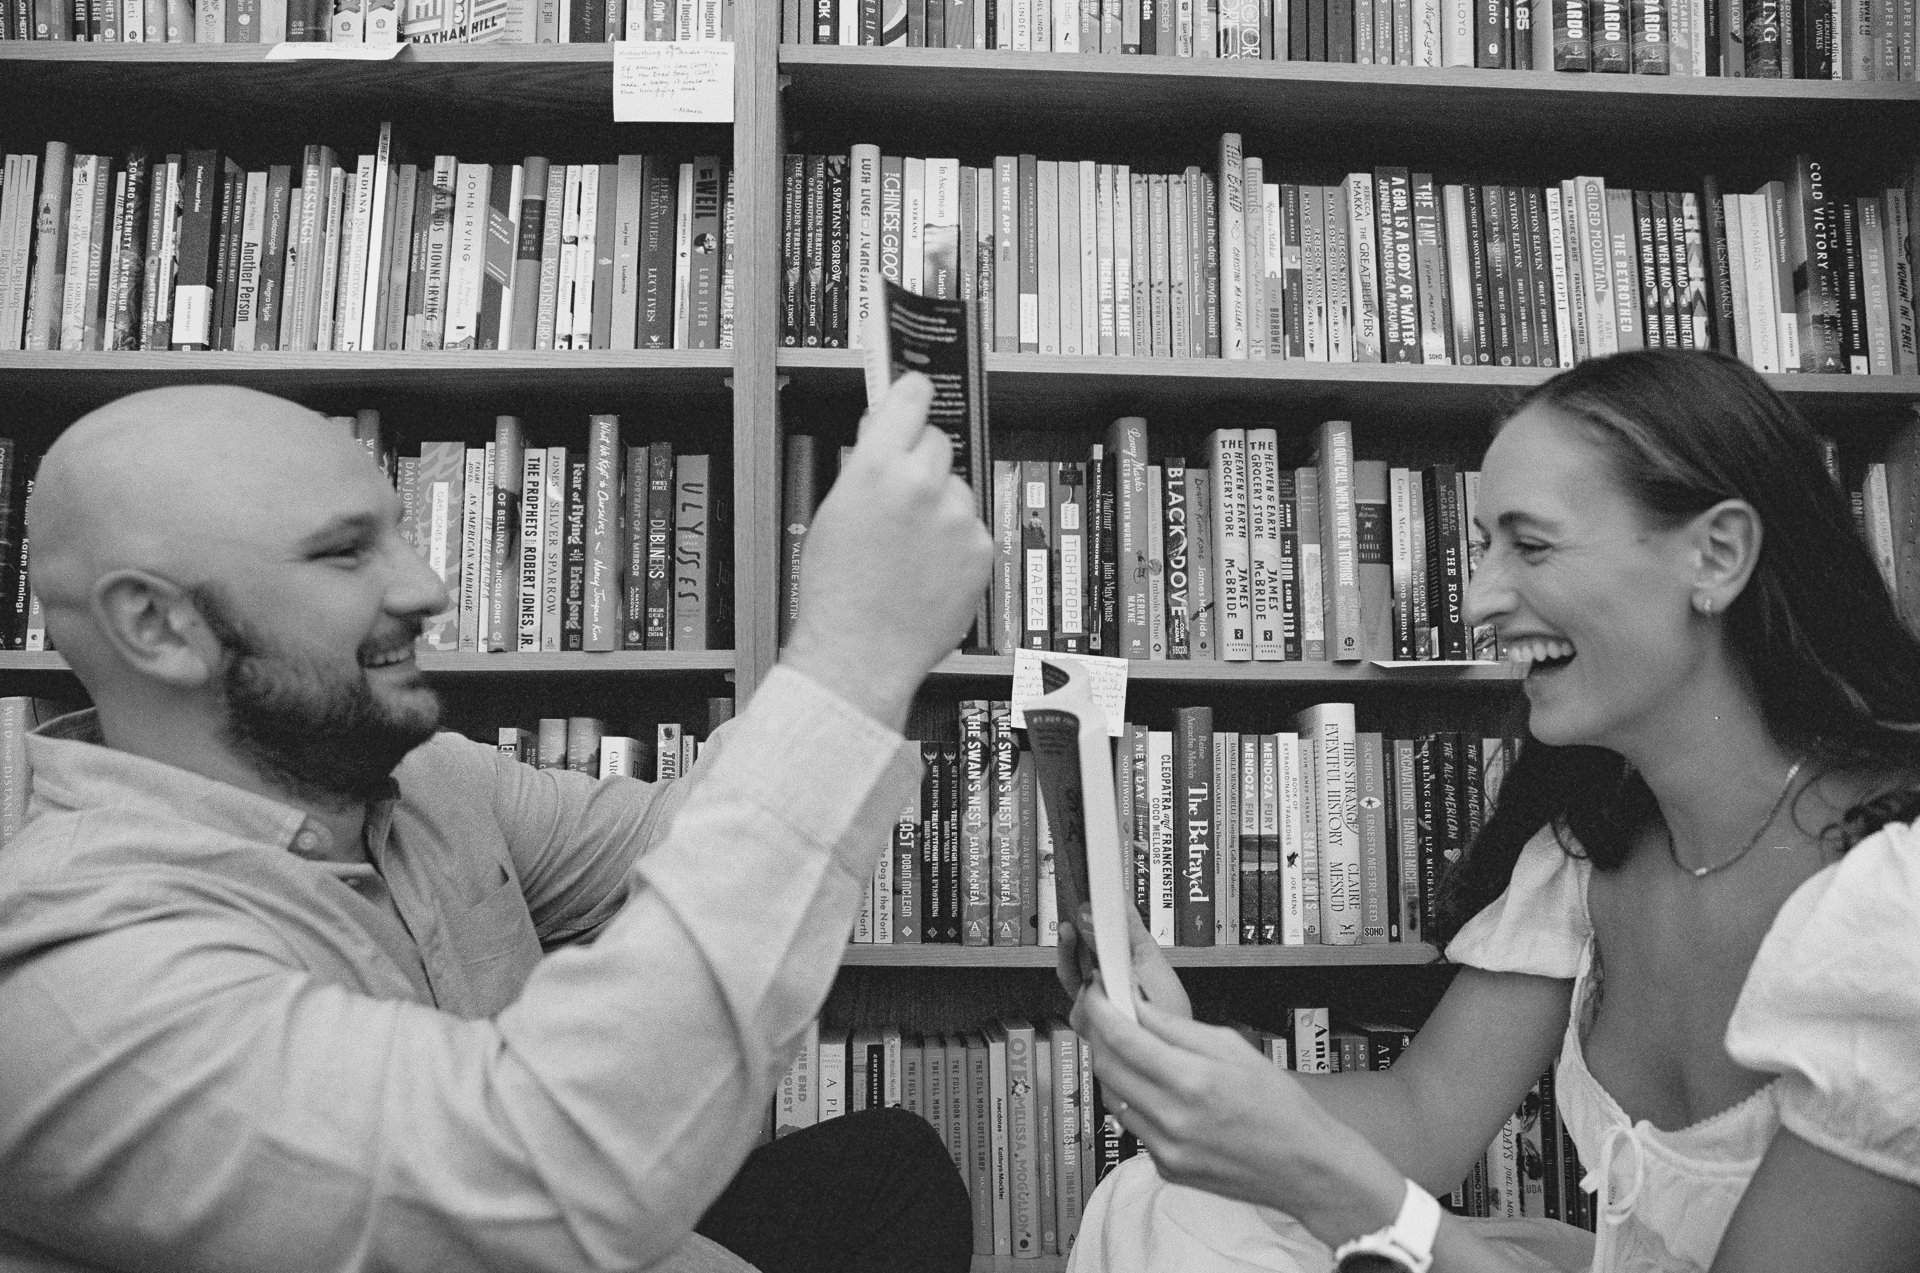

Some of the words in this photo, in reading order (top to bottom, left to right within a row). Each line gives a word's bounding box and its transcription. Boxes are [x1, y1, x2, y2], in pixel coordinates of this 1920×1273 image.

[413, 26, 466, 43] NATHAN
[472, 16, 497, 34] HILL
[1885, 32, 1893, 66] NAMES
[127, 161, 137, 199] TOWARD
[437, 170, 448, 188] THE
[861, 158, 871, 183] LUSH
[1002, 164, 1010, 182] THE
[1392, 177, 1405, 185] A
[1810, 163, 1823, 200] COLD
[234, 183, 243, 204] JENNY
[273, 199, 282, 212] Last
[274, 186, 283, 197] The
[359, 166, 370, 214] INDIANA
[467, 174, 476, 208] JOHN
[861, 188, 871, 216] LIVES
[1002, 187, 1010, 211] WIFE
[1207, 180, 1215, 215] mother
[1353, 180, 1363, 221] MAKKAI
[1363, 185, 1371, 216] REBECCA
[1393, 188, 1407, 213] GIRL
[1586, 184, 1600, 226] GILDED
[124, 202, 134, 248] ETERNITY
[234, 205, 242, 223] HVAL
[432, 191, 447, 232] ISLANDS
[832, 188, 841, 237] SPARTAN'S
[1002, 214, 1010, 233] APP
[1208, 217, 1215, 227] in
[1530, 194, 1539, 232] STATION
[269, 213, 280, 255] Catastrophe
[462, 215, 473, 261] IRVING
[1208, 229, 1216, 244] the
[1360, 227, 1368, 240] THE
[1395, 231, 1409, 239] A
[1614, 234, 1626, 255] THE
[1672, 218, 1684, 241] SALLY
[1814, 208, 1828, 269] VICTORY
[88, 243, 101, 291] ZORRIE
[230, 234, 238, 267] PARADISE
[241, 241, 258, 282] Another
[429, 243, 443, 281] DIONNE
[831, 240, 841, 282] SORROW
[1208, 246, 1217, 267] dark
[1359, 242, 1370, 279] GREAT
[1382, 227, 1396, 289] NANSUBUGA
[1396, 244, 1412, 280] BODY
[1533, 235, 1543, 270] ELEVEN
[1591, 229, 1606, 292] MOUNTAIN
[1675, 245, 1686, 264] WEN
[120, 258, 130, 288] ANTON
[264, 279, 275, 302] Allegra
[647, 268, 657, 295] LUCY
[699, 268, 709, 295] LARS
[1207, 277, 1216, 304] kayla
[1676, 266, 1688, 287] MAO
[1897, 262, 1910, 301] WOMEN!
[119, 292, 127, 311] HUR
[238, 286, 254, 322] Person
[426, 286, 440, 321] IRVING
[647, 298, 656, 322] IVES
[1362, 281, 1374, 337] BELIEVERS
[1400, 285, 1412, 300] OF
[1616, 261, 1633, 332] BETROTHED
[263, 303, 273, 321] Hyde
[697, 301, 707, 327] IYER
[1209, 307, 1217, 338] maiuri
[1387, 292, 1399, 342] MAKUMBI
[1401, 304, 1415, 346] WATER
[1901, 306, 1912, 319] IN!
[1270, 308, 1280, 354] BORROWER
[1902, 324, 1915, 354] PERIL!
[1250, 442, 1273, 450] THE
[527, 457, 540, 476] THE
[572, 463, 585, 490] Fear
[1251, 454, 1262, 500] GROCERY
[1264, 454, 1274, 492] HEAVEN
[525, 481, 539, 536] PROPHETS
[572, 492, 580, 503] of
[1168, 468, 1185, 537] BLACK
[548, 502, 560, 545] SILVER
[568, 504, 583, 544] Flying
[1253, 504, 1263, 539] STORE
[1267, 505, 1277, 540] EARTH
[20, 538, 29, 566] Karen
[649, 520, 666, 578] DUBLINERS
[677, 483, 704, 602] ULYSSES
[522, 547, 536, 589] ROBERT
[791, 542, 800, 580] VALERIE
[1446, 548, 1456, 575] THE
[16, 570, 28, 613] Jennings
[547, 553, 557, 615] SPARROW
[570, 567, 582, 598] Erica
[1031, 554, 1043, 626] TRAPEZE
[1065, 539, 1077, 629] TIGHTROPE
[1170, 555, 1187, 616] DOVE
[1254, 560, 1266, 620] McBRIDE
[1267, 569, 1278, 610] JAMES
[520, 592, 535, 629] JONES,
[566, 598, 580, 629] Jong
[790, 583, 799, 619] MARTIN
[1448, 584, 1458, 623] ROAD
[520, 633, 533, 649] JR.
[999, 715, 1011, 738] THE
[999, 742, 1011, 792] SWAN'S
[1263, 743, 1273, 799] MENDOZA
[1324, 723, 1339, 785] EVENTFUL
[1343, 741, 1355, 768] THIS
[1122, 755, 1130, 815] NORTHWOOD
[1161, 755, 1172, 810] CLEOPATRA
[1188, 782, 1208, 816] The
[1344, 772, 1358, 828] STRANGE
[999, 797, 1011, 827] NEST
[1152, 798, 1160, 820] COCO
[1160, 814, 1172, 830] and
[1264, 803, 1274, 830] FURY
[1327, 790, 1342, 845] HISTORY
[1000, 837, 1010, 867] LAURA
[1152, 825, 1160, 864] MELLORS
[1183, 819, 1209, 902] Betrayed
[901, 854, 911, 878] ROBIN
[1162, 833, 1172, 908] FRANKENSTEIN
[1000, 870, 1010, 906] McNEAL
[1329, 862, 1344, 912] MESSUD
[1348, 863, 1360, 910] CLAIRE
[1061, 1041, 1072, 1057] ALL
[1062, 1059, 1073, 1095] FRIENDS
[1063, 1098, 1073, 1113] ARE
[1063, 1117, 1075, 1165] NECESSARY
